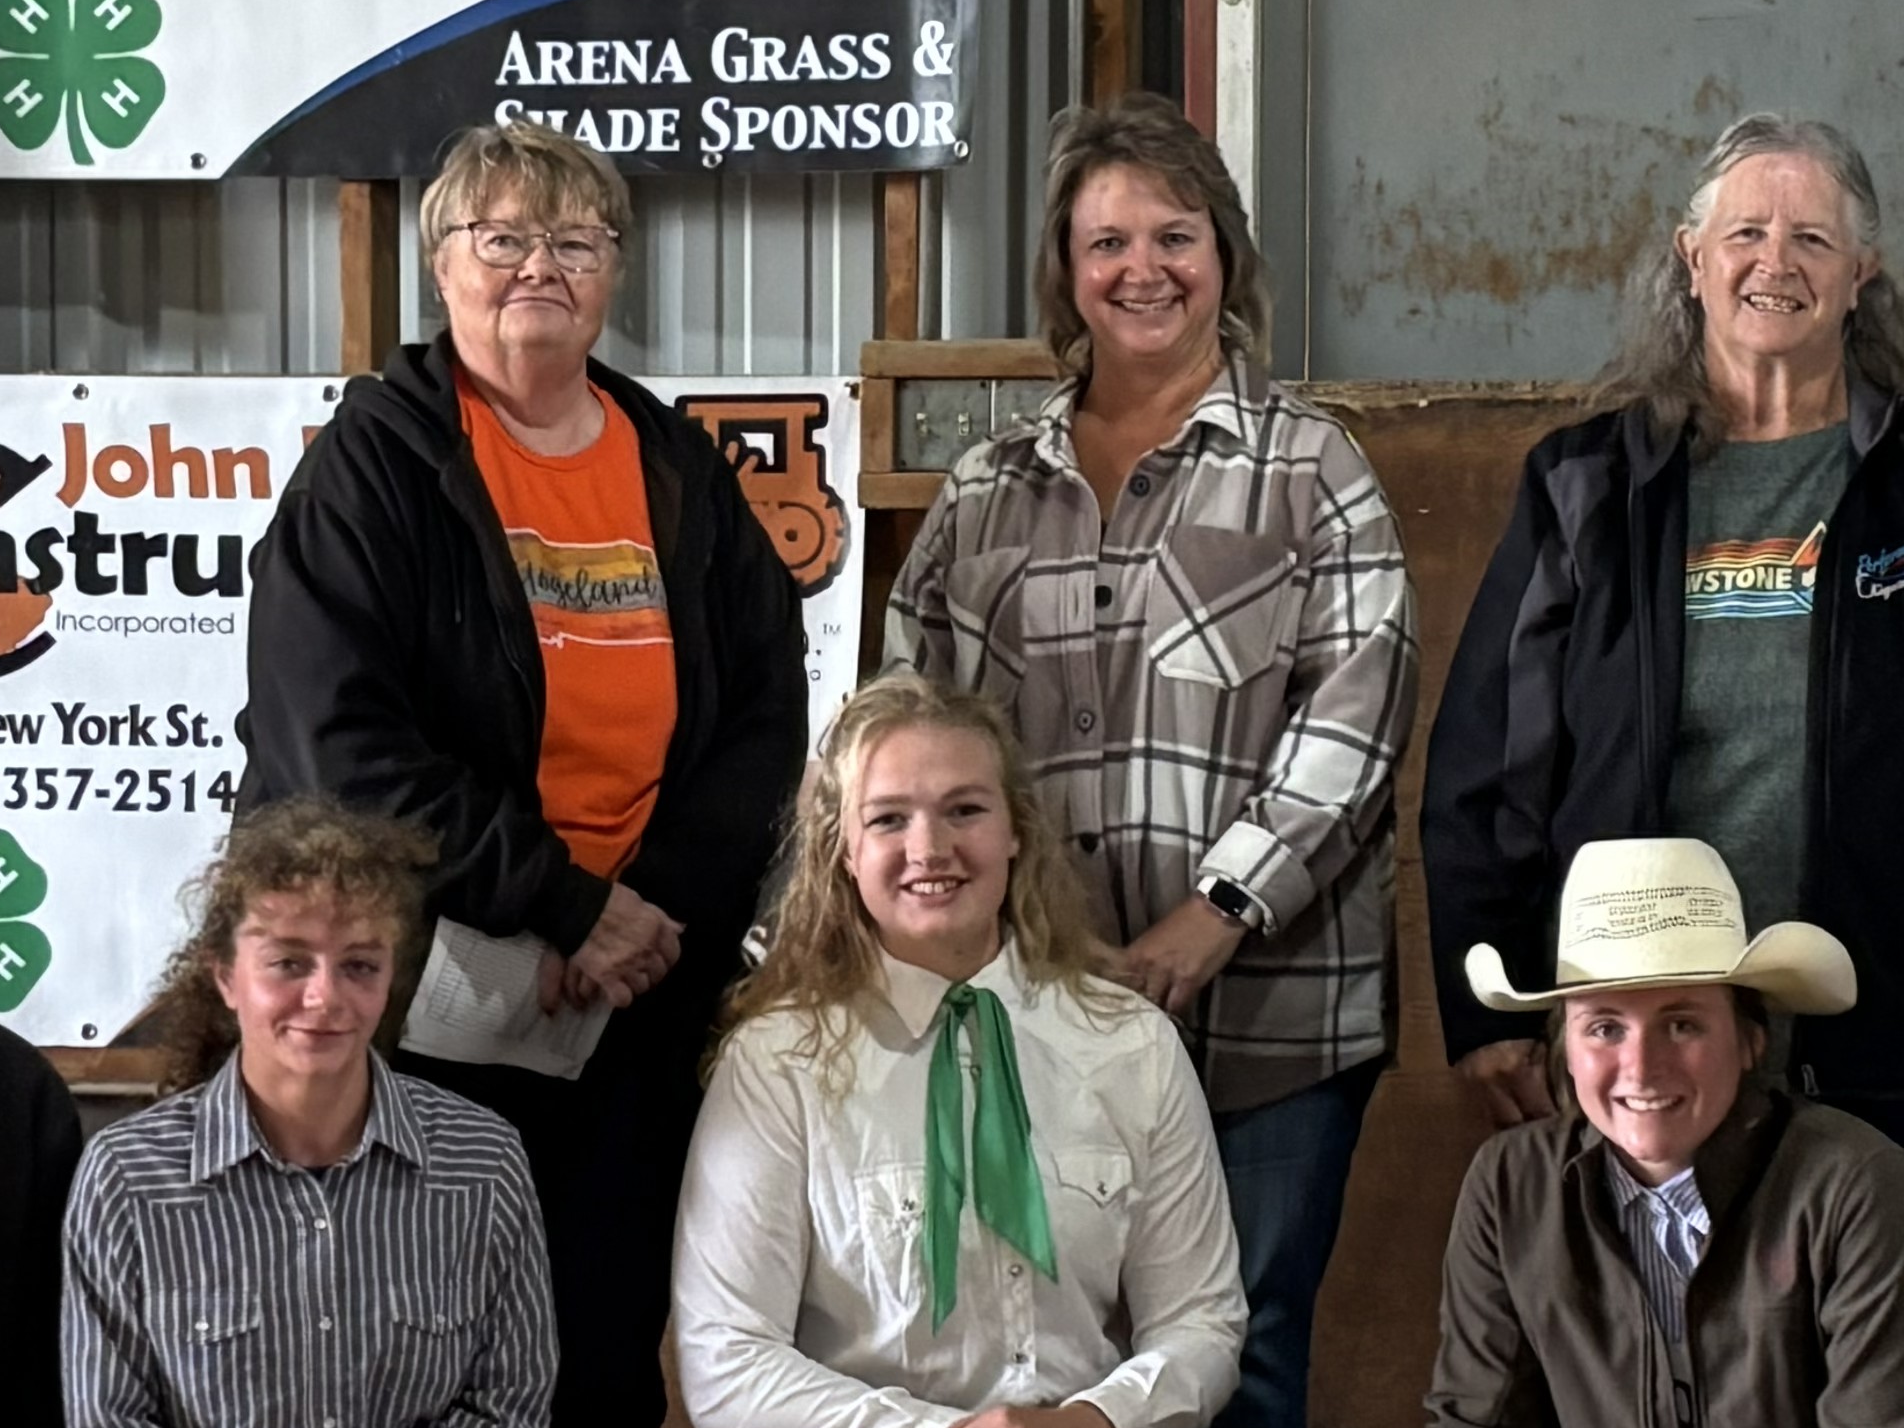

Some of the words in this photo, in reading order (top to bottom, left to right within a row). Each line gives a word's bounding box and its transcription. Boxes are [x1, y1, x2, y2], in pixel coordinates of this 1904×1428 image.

[495, 31, 691, 85] ARENA
[711, 27, 891, 83] GRASS
[913, 20, 955, 77] &
[699, 98, 958, 154] SPONSOR
[55, 420, 274, 510] John
[56, 610, 234, 638] Incorporated
[51, 702, 157, 746] York
[166, 704, 223, 747] St.
[3, 765, 238, 818] 357-2514
